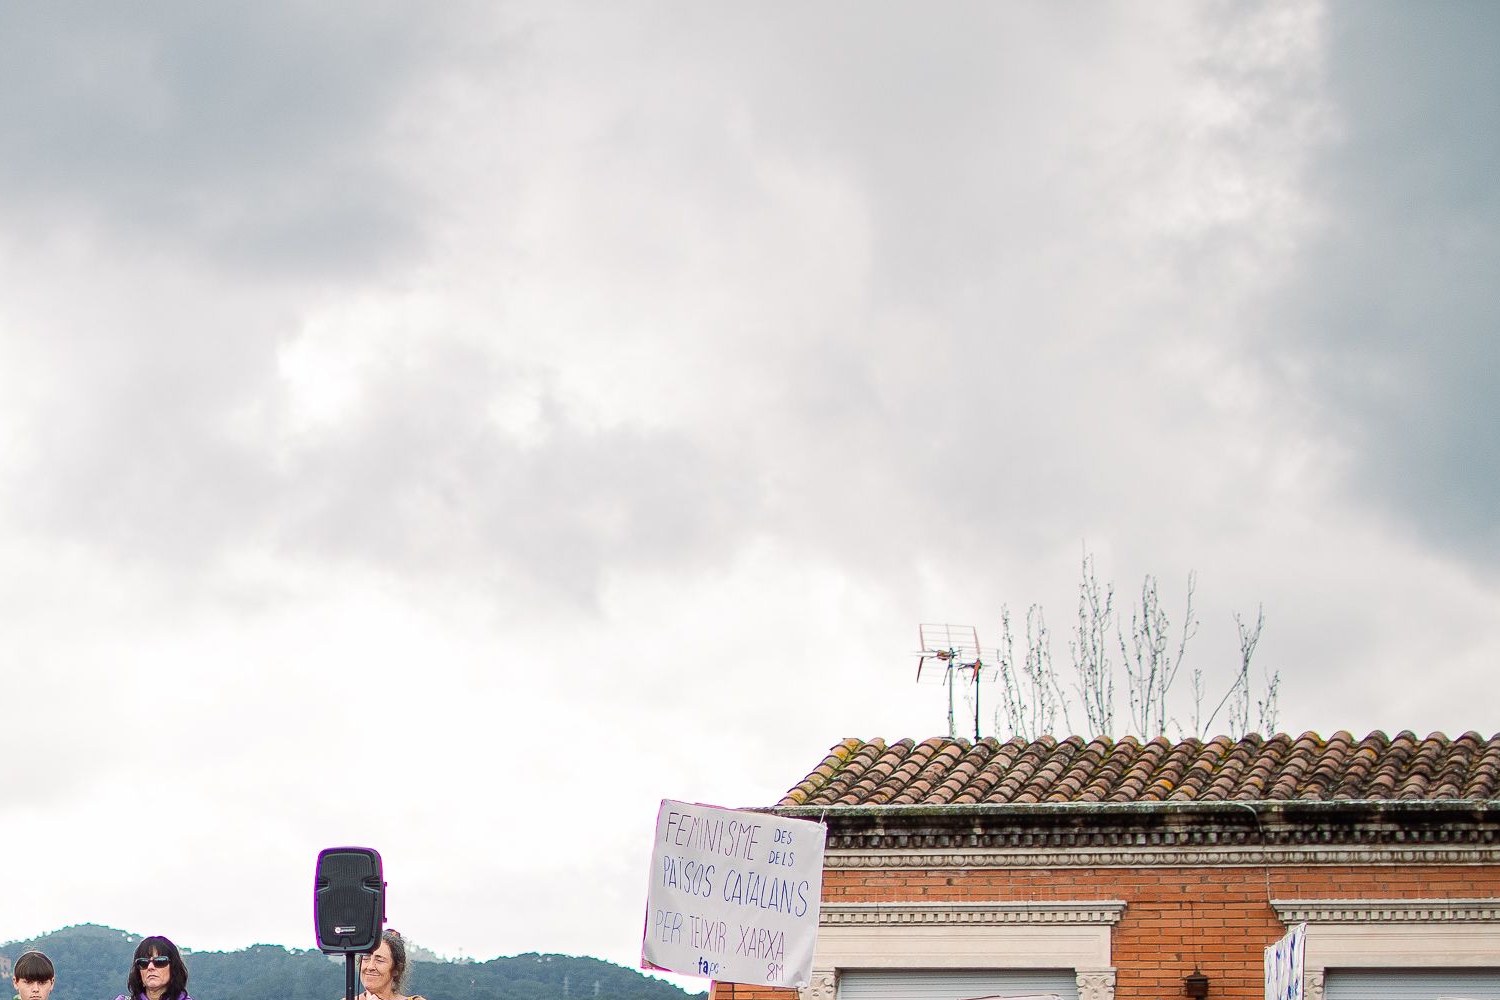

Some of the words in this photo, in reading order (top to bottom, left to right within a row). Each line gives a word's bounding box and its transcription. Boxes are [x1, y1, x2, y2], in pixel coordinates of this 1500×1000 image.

[666, 812, 761, 861] FEMINISME
[773, 828, 793, 845] DES
[768, 850, 795, 867] DELS
[662, 855, 716, 898] PAÏSOS
[723, 869, 809, 918] CATALANS
[655, 909, 683, 945] PER
[689, 913, 728, 954] TEIXIR
[735, 924, 785, 962] XARXA
[766, 963, 784, 983] 8M
